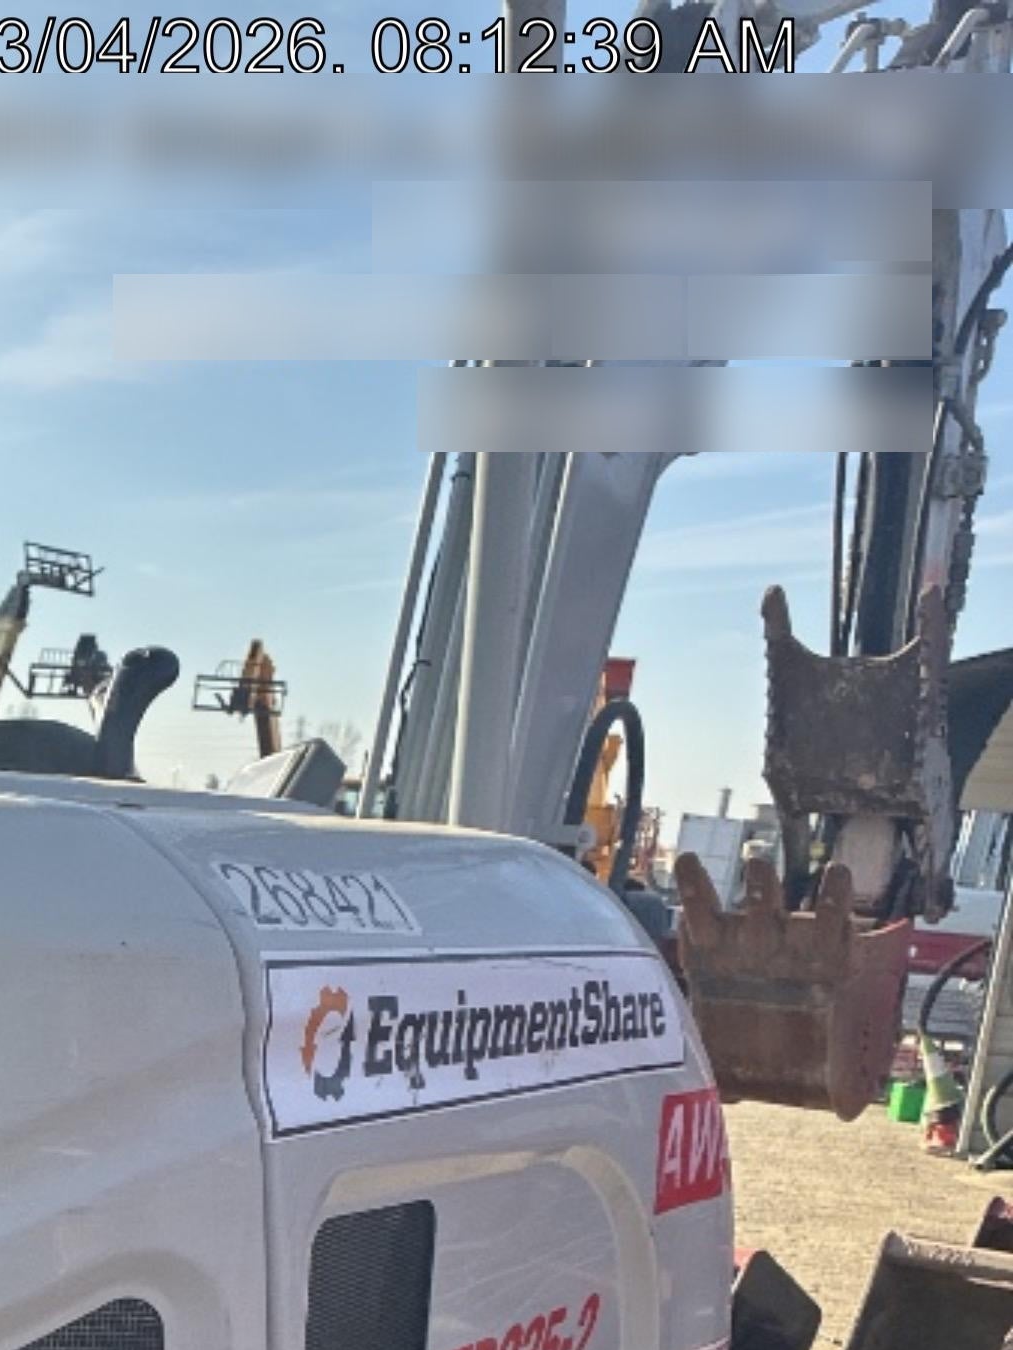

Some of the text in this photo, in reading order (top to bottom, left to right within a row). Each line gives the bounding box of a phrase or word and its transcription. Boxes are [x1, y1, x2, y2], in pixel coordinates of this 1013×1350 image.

[221, 864, 414, 930] 268421
[363, 980, 665, 1088] EquipmentShare
[662, 1101, 730, 1188] AW
